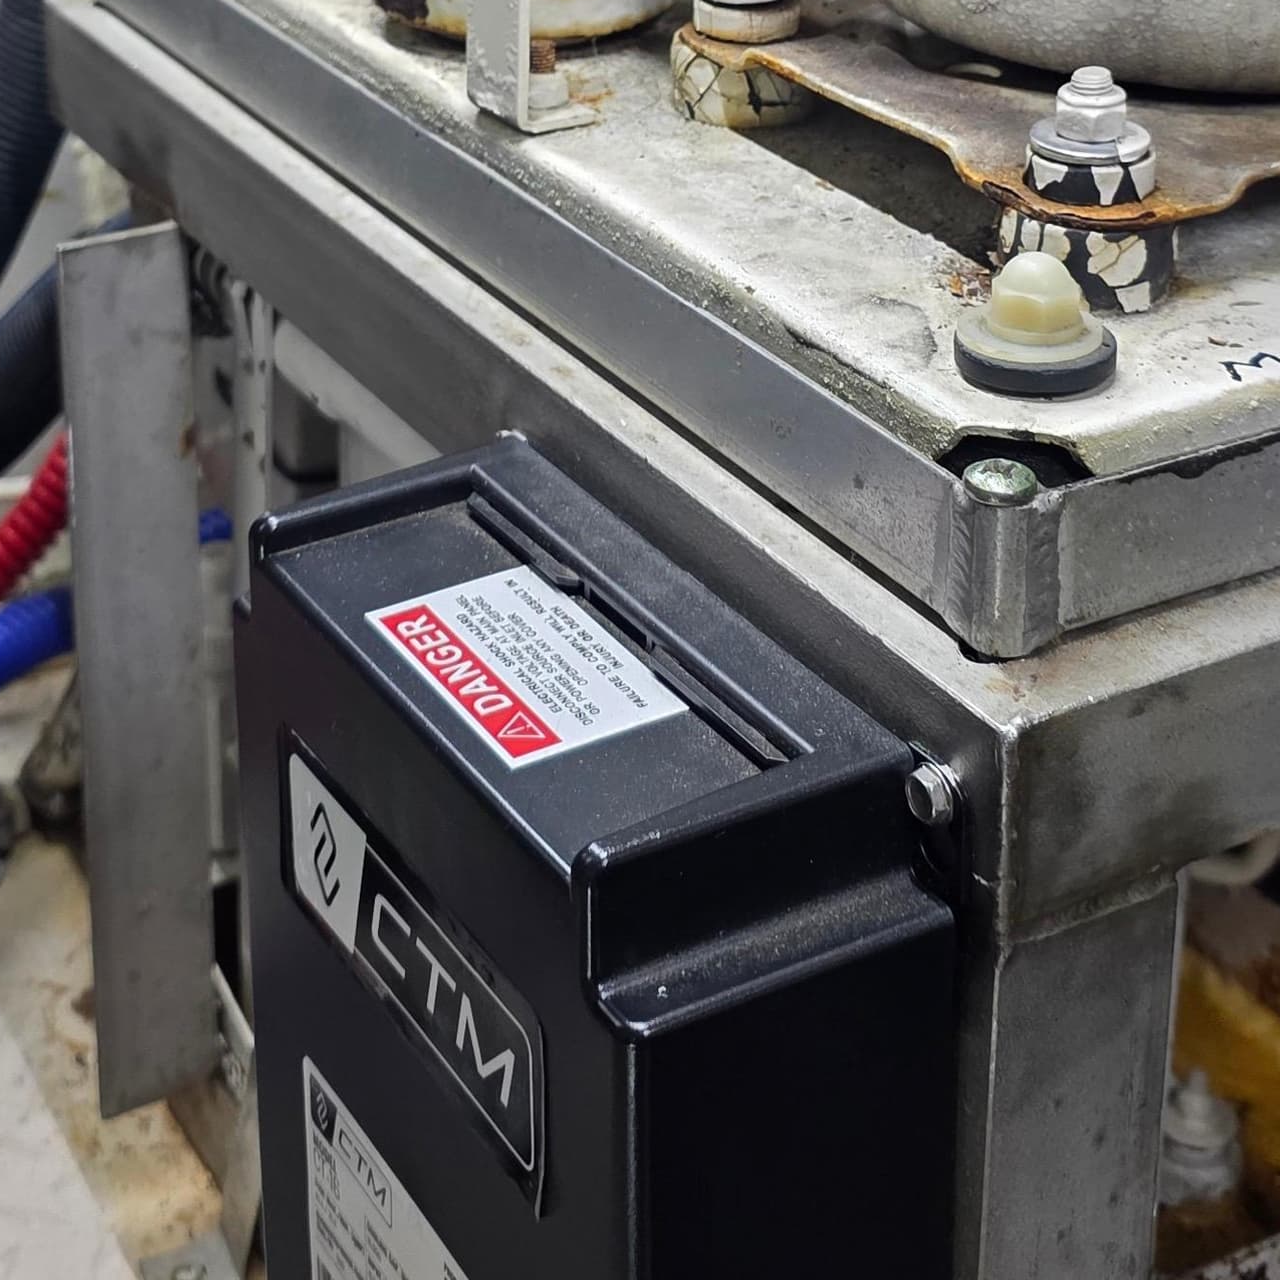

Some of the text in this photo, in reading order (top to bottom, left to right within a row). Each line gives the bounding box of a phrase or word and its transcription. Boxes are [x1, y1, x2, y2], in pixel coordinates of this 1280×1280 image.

[390, 614, 517, 716] DANGER
[452, 594, 596, 725] DISCONNECT VOLTAGE AT MAIN PANEL
[454, 613, 564, 713] ELECTRICAL SHOCK HAZARD
[470, 595, 602, 715] OR POWER SOURCE INLET BEFORE
[503, 579, 650, 708] FAILURE TO COMPLY WILL RESULT IN
[505, 612, 591, 686] OPENING ANY COVER
[548, 605, 624, 668] INJURY OR DEATH
[372, 893, 515, 1108] CTM
[339, 1128, 387, 1206] CTM
